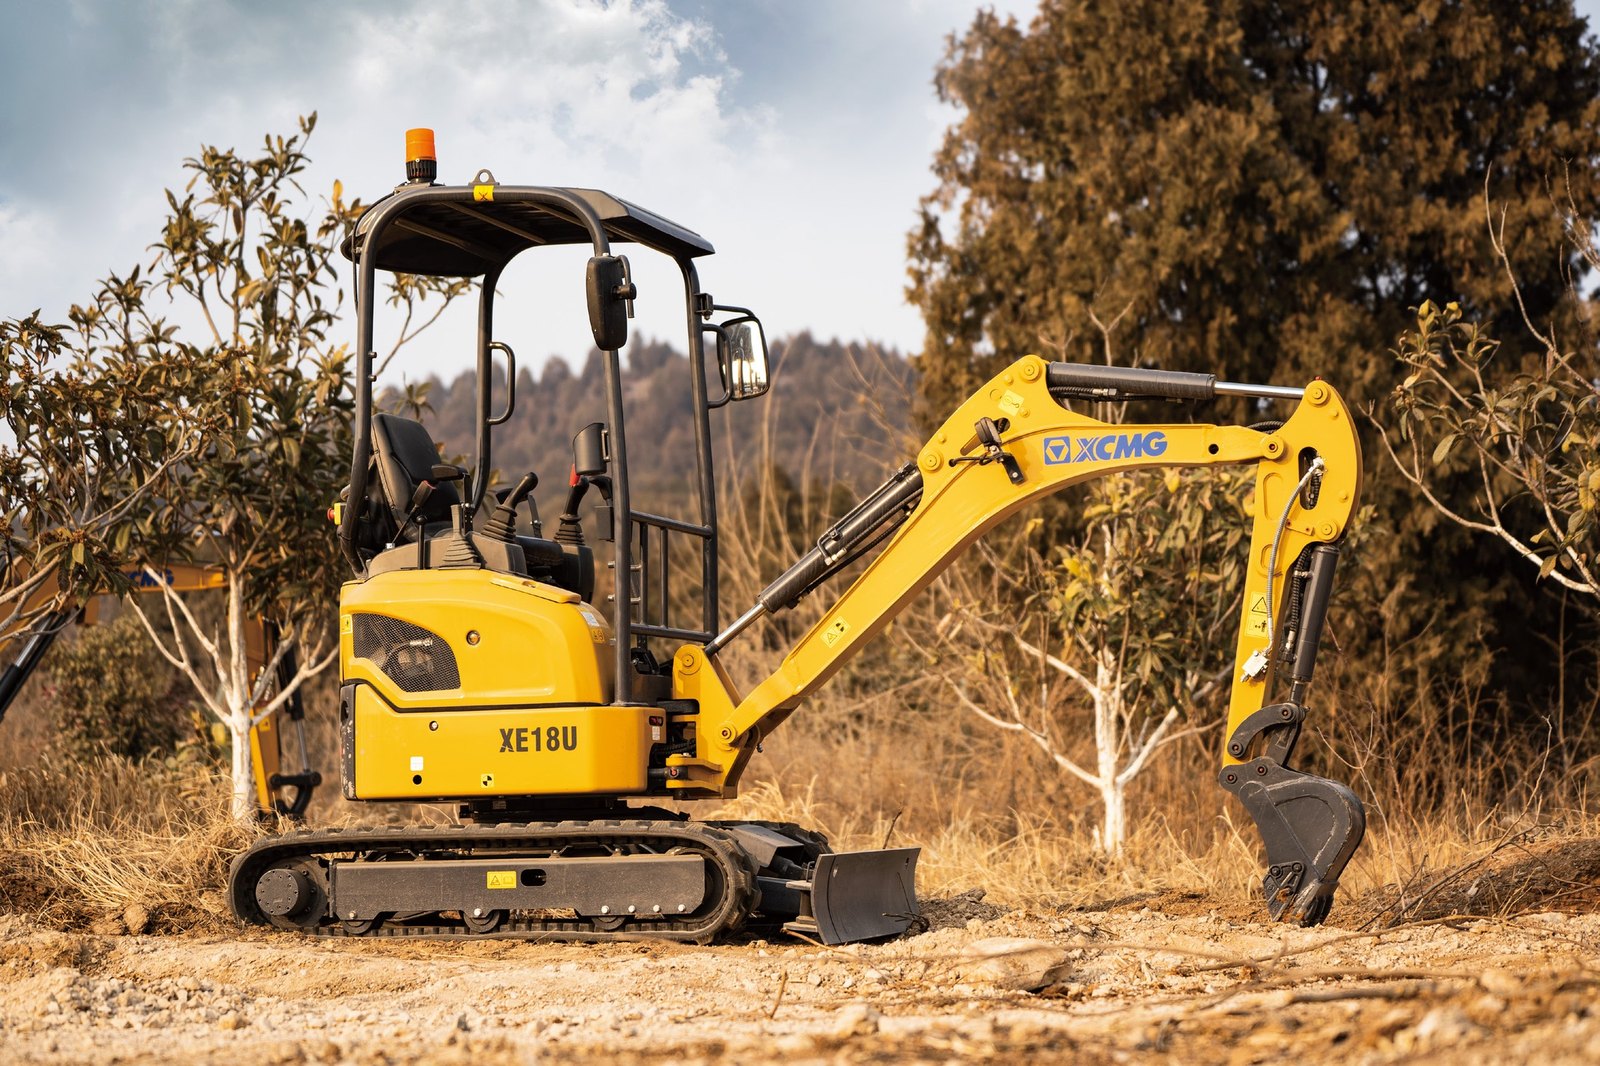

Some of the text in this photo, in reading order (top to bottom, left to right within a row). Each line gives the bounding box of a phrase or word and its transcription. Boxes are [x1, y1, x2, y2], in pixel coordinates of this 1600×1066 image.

[1072, 432, 1167, 462] XCMG
[128, 568, 174, 586] CMG
[499, 726, 577, 752] XE18U
